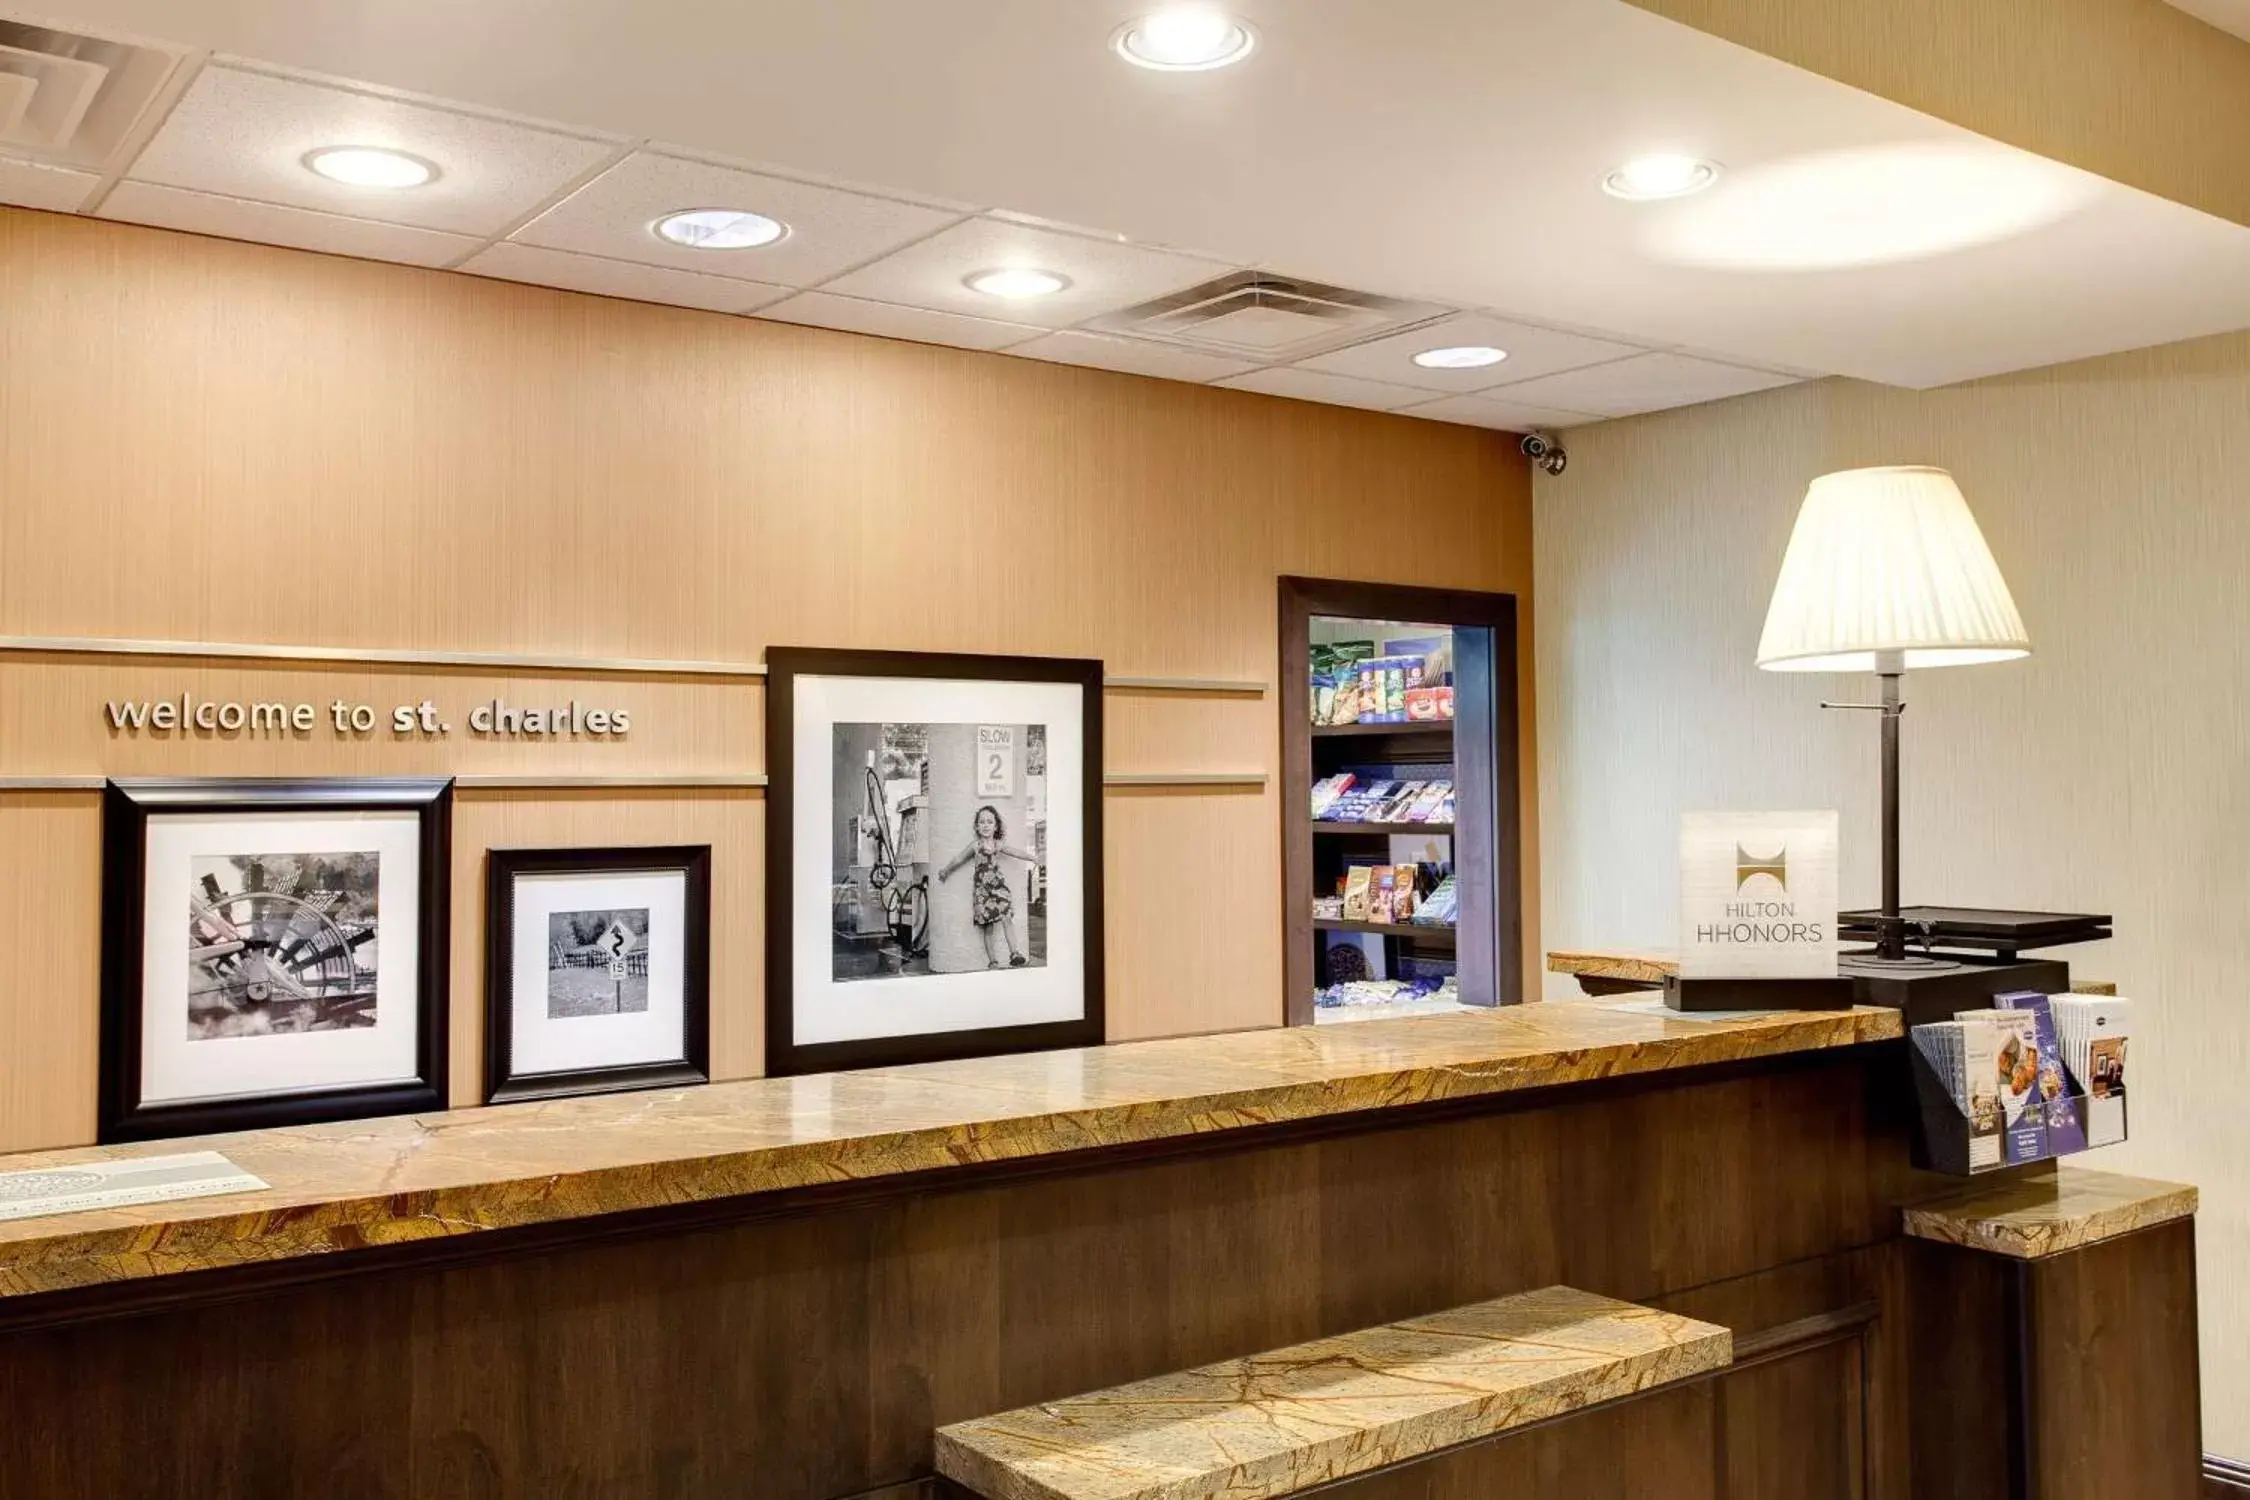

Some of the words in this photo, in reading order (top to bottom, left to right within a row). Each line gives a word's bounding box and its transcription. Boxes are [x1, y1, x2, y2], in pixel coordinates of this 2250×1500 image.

[107, 691, 316, 731] welcome
[330, 700, 376, 732] to
[392, 700, 451, 733] st.
[469, 698, 631, 734] charles
[980, 728, 1011, 743] SLOW
[988, 754, 1004, 779] 2
[1726, 902, 1795, 918] HILTON
[1697, 923, 1823, 943] HHONORS
[612, 963, 625, 973] 15
